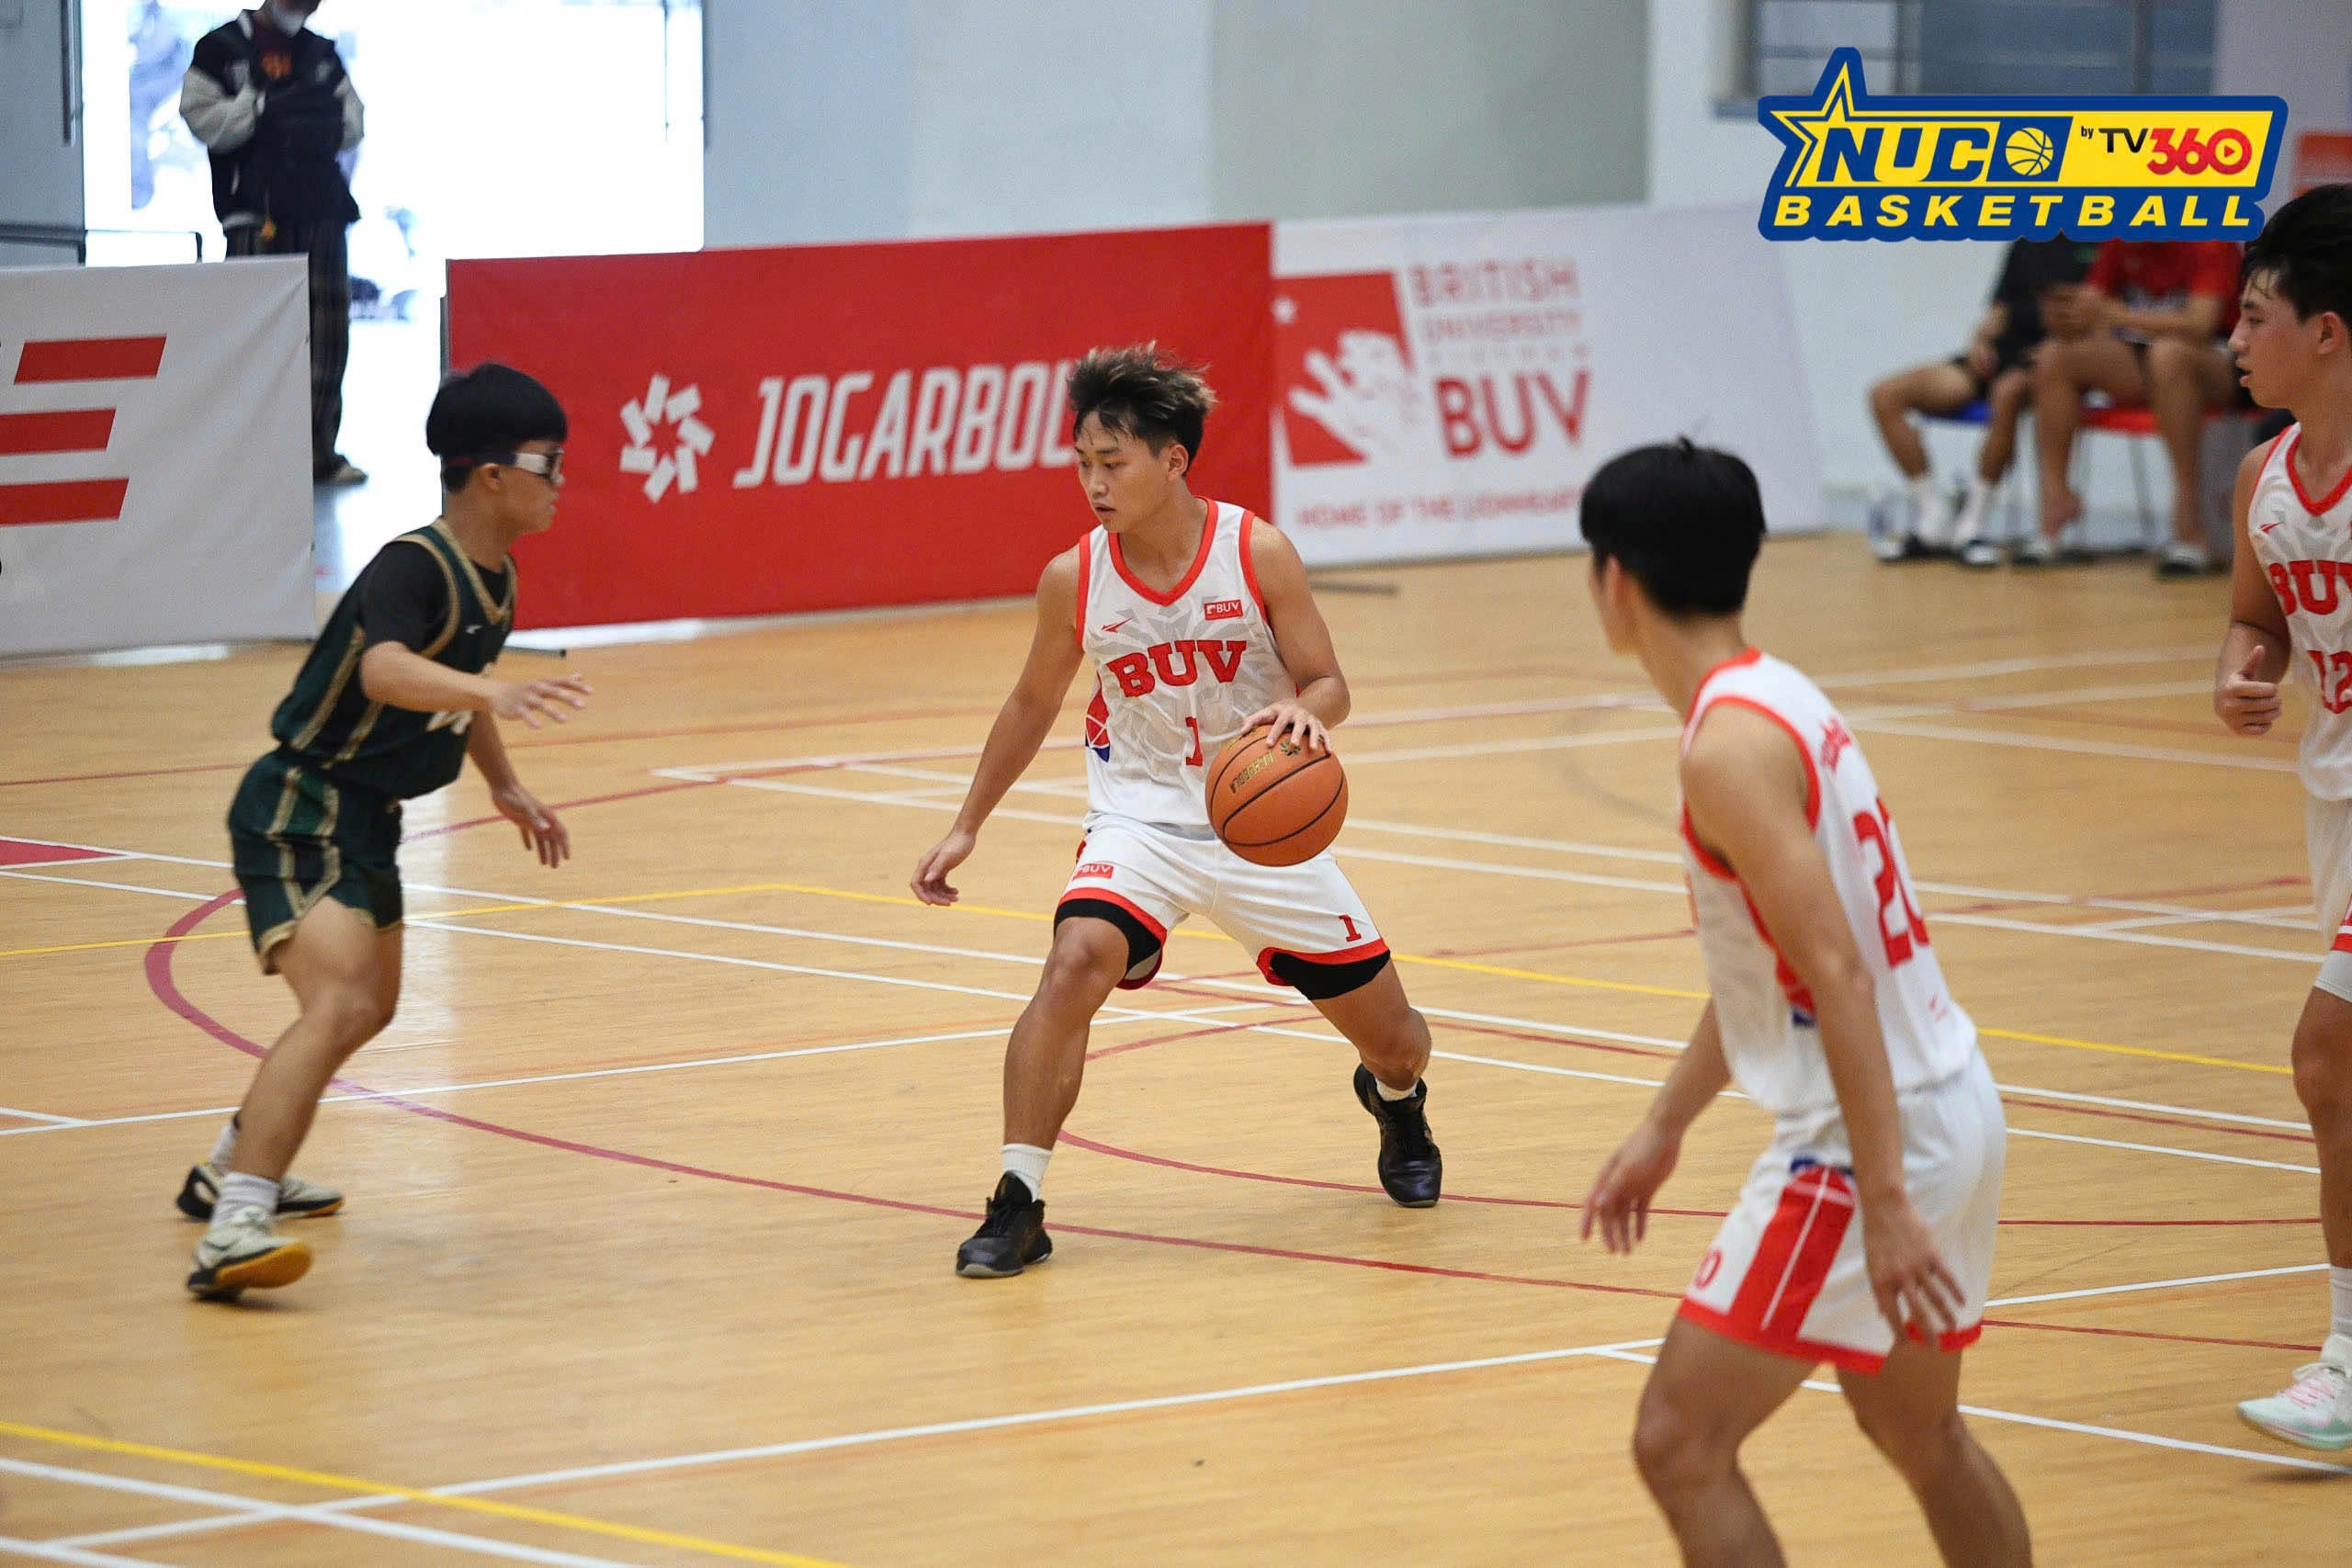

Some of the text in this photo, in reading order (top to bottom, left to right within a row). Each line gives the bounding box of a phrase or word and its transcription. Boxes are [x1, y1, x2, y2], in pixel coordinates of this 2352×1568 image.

[1410, 258, 1580, 308] BRITISH
[1433, 367, 1593, 459] BUV
[1216, 602, 1239, 614] BUV
[2268, 559, 2352, 616] BU
[1105, 639, 1248, 698] BUV
[1184, 716, 1204, 767] 1
[1339, 914, 1362, 942] 1
